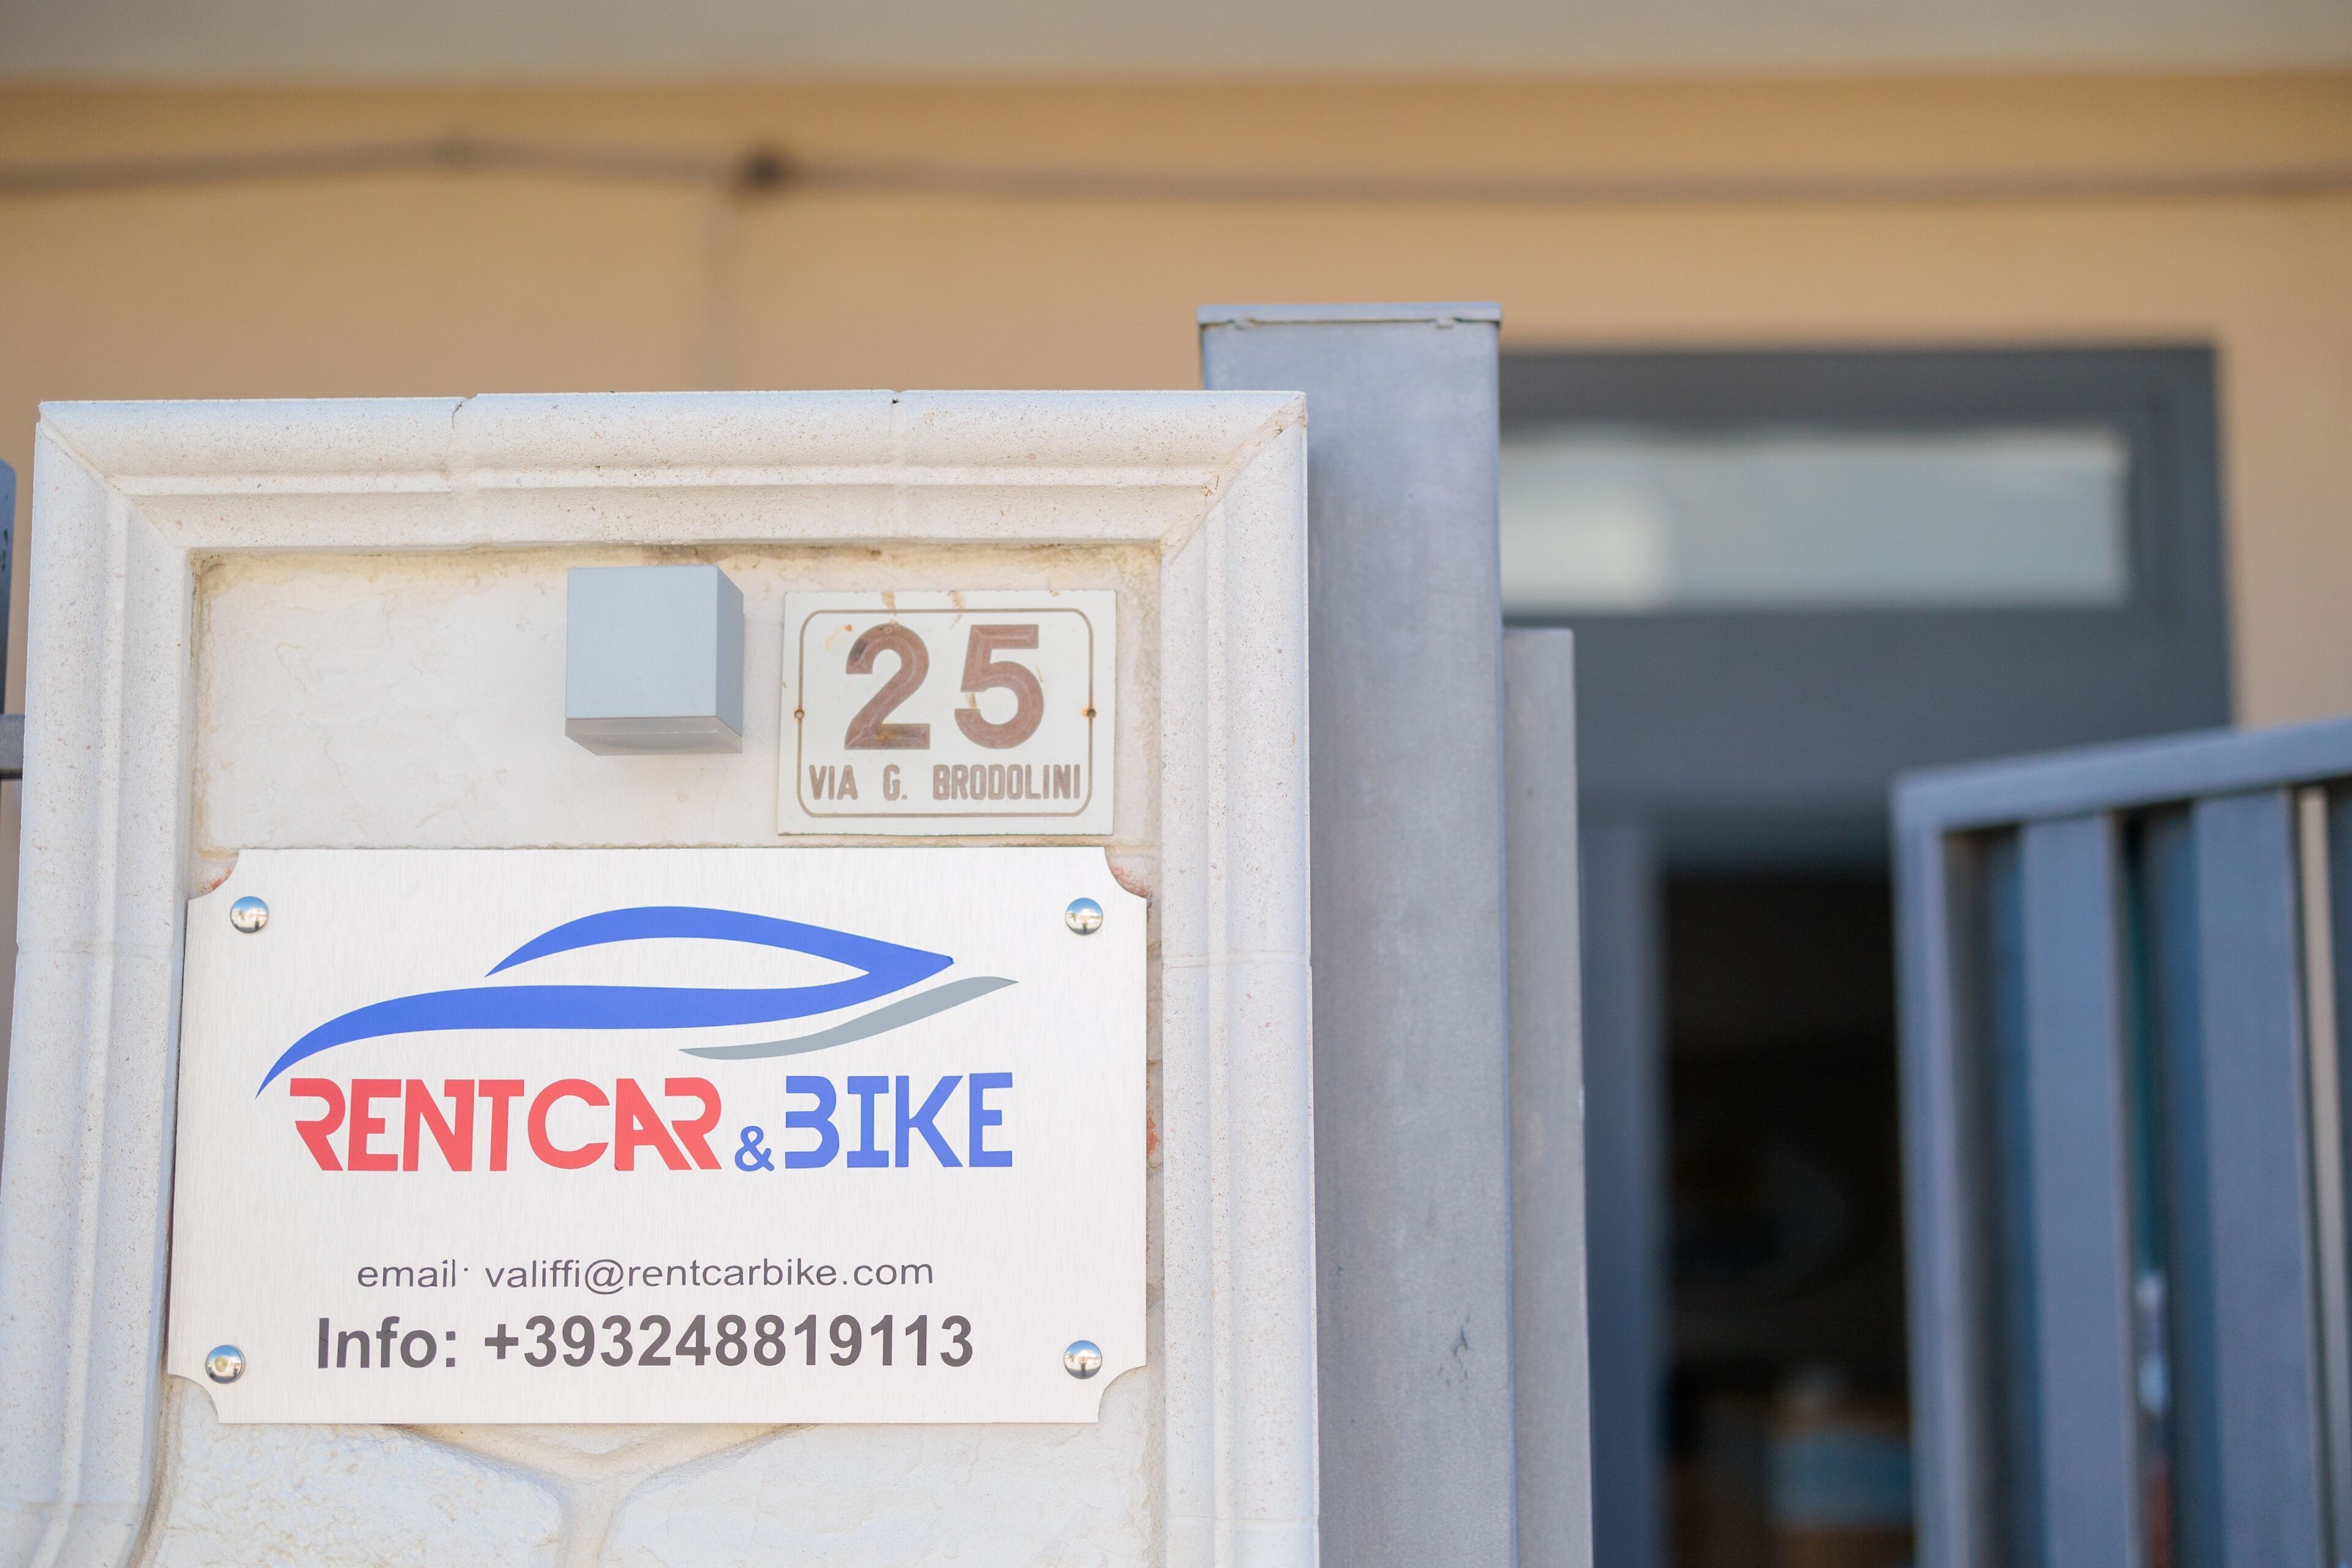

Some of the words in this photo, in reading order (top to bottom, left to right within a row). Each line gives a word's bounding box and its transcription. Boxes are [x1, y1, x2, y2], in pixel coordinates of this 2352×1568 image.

[844, 622, 1044, 750] 25
[809, 764, 858, 800] VIA
[883, 764, 908, 801] G.
[933, 764, 1080, 800] BRODOLINI
[734, 1125, 775, 1172] &
[784, 1072, 1013, 1169] BIKE
[484, 1257, 933, 1295] valiffi@rentcarbike.com
[318, 1316, 457, 1369] Info:
[484, 1314, 974, 1368] +393248819113
